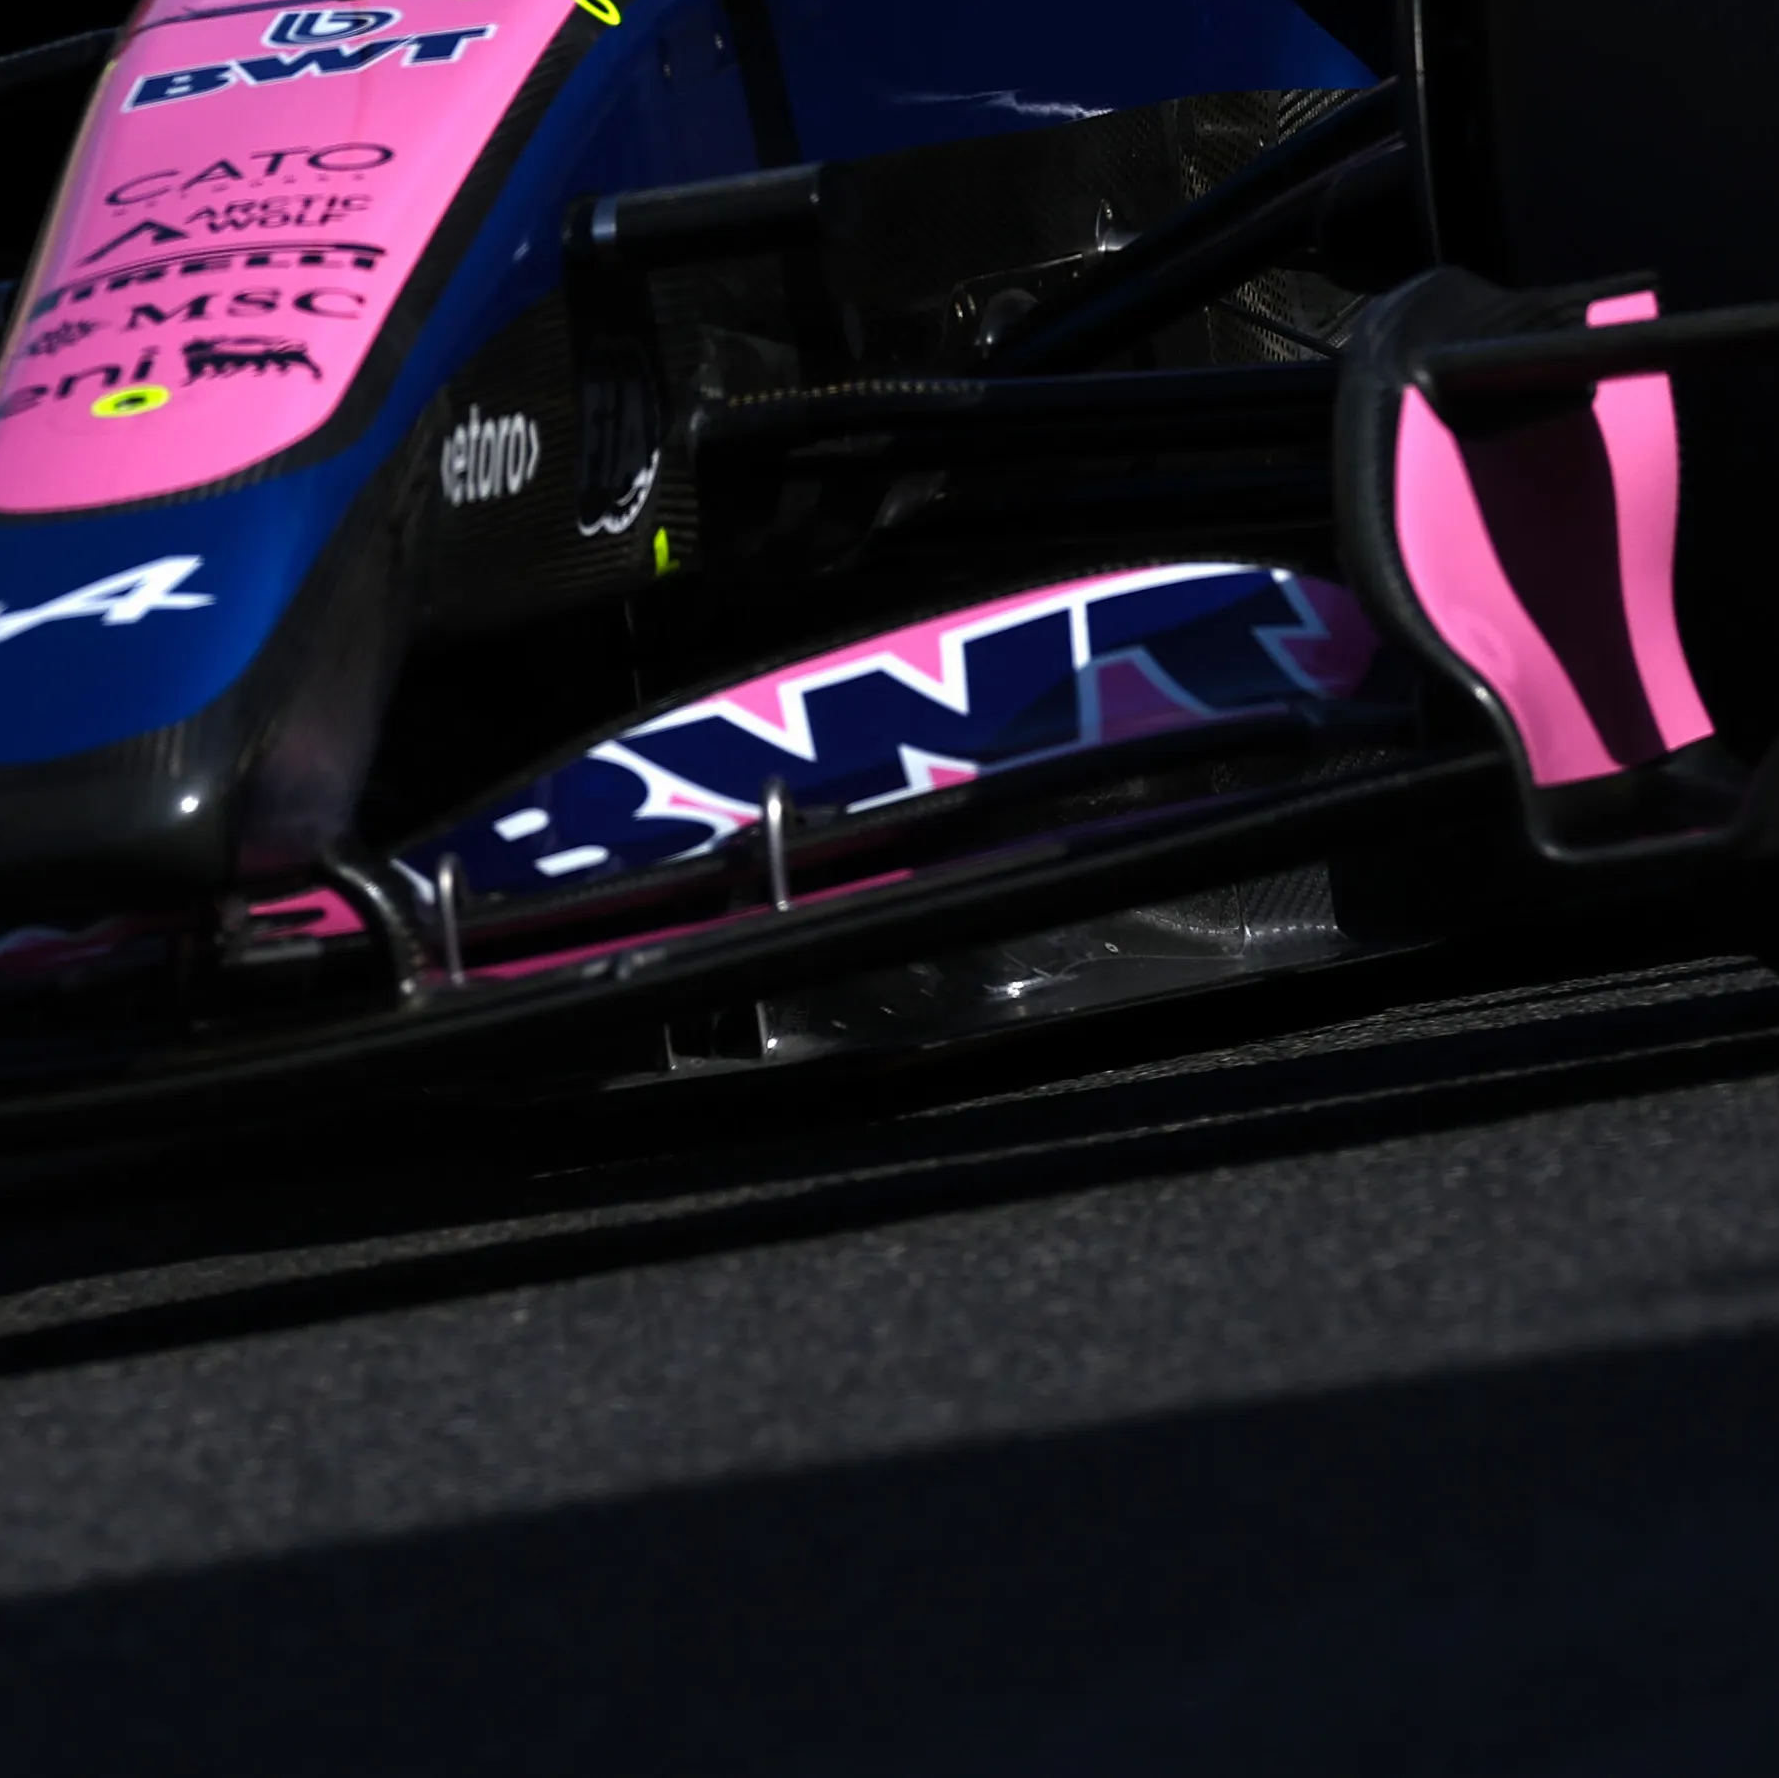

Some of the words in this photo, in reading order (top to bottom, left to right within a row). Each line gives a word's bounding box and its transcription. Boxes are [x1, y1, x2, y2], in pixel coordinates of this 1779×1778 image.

[121, 23, 497, 114] BWT
[105, 142, 394, 207] CATO
[185, 195, 372, 225] ARCTIC
[207, 209, 347, 234] WOLF
[120, 286, 367, 332] MSC
[394, 563, 1328, 894] BWT
